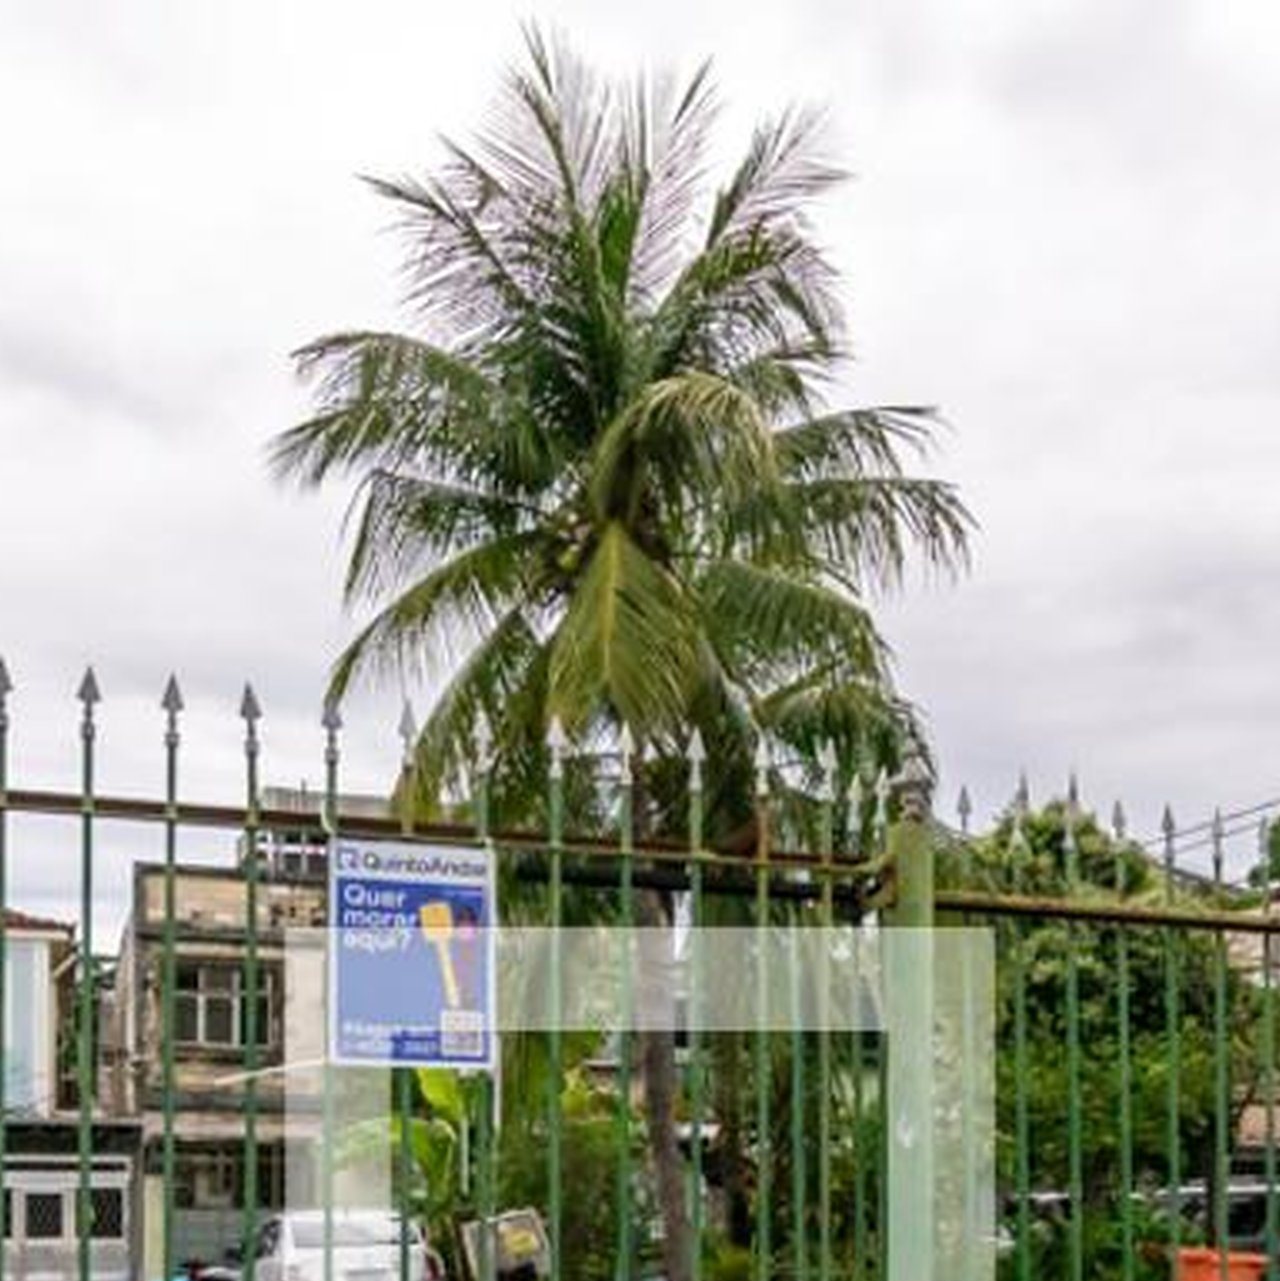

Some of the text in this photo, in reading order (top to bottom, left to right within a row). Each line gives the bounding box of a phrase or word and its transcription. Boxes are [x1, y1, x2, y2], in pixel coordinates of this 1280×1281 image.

[344, 883, 407, 907] Quer
[344, 909, 417, 928] morar
[344, 930, 412, 954] aqui?
